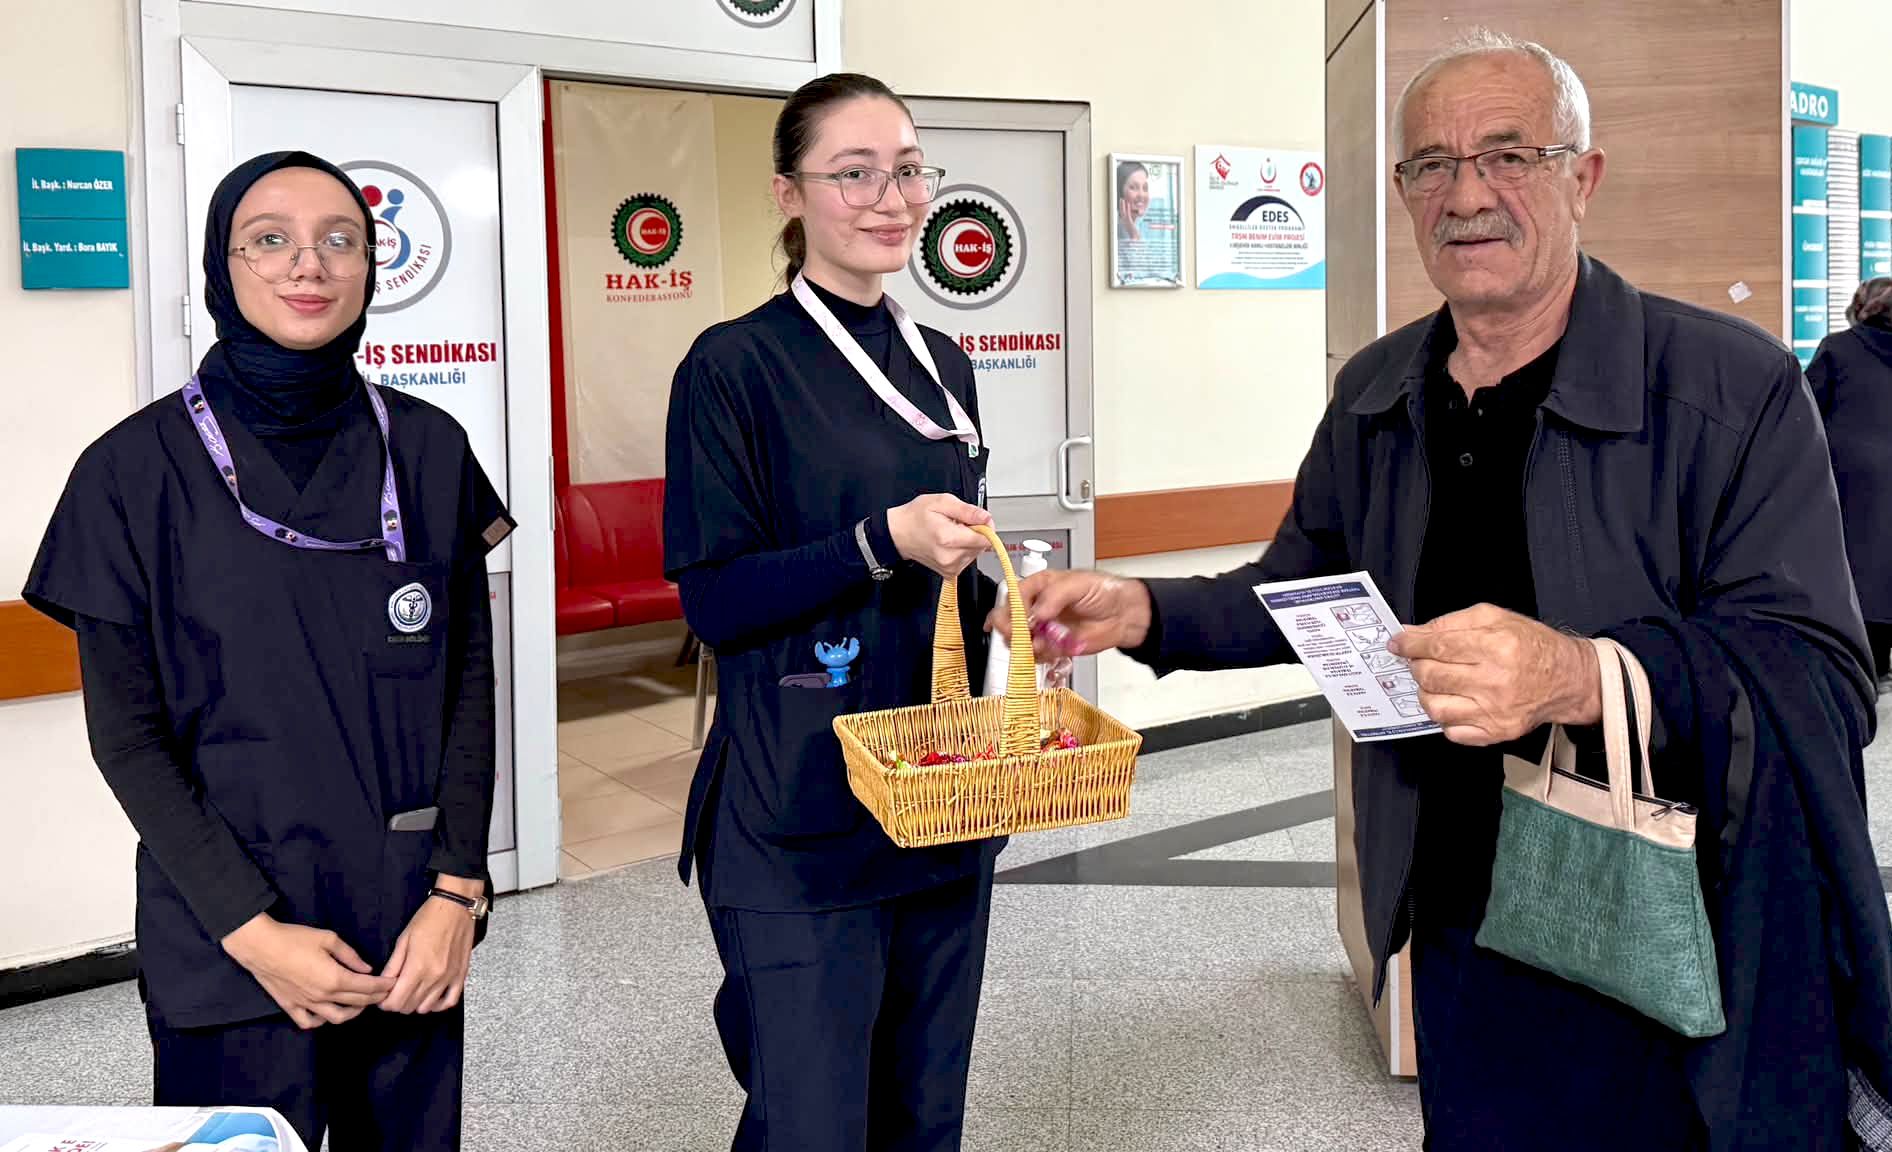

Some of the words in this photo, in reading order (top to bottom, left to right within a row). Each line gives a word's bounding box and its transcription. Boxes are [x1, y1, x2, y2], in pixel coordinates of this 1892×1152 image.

[66, 179, 93, 190] Nurcan
[93, 178, 113, 190] ÖZER
[1262, 210, 1289, 223] EDES
[955, 241, 992, 255] HAK-İŞ
[385, 244, 433, 291] SENDİKASI
[605, 269, 693, 291] HAK-İŞ
[606, 290, 693, 303] KONFEDERASYONU
[960, 332, 975, 356] İŞ
[979, 331, 1061, 353] SENDİKASI
[357, 341, 386, 369] -İŞ
[391, 340, 497, 365] SENDİKASI
[972, 355, 1037, 372] BAŞKANLIĞI
[380, 367, 467, 389] BAŞKANLIĞI
